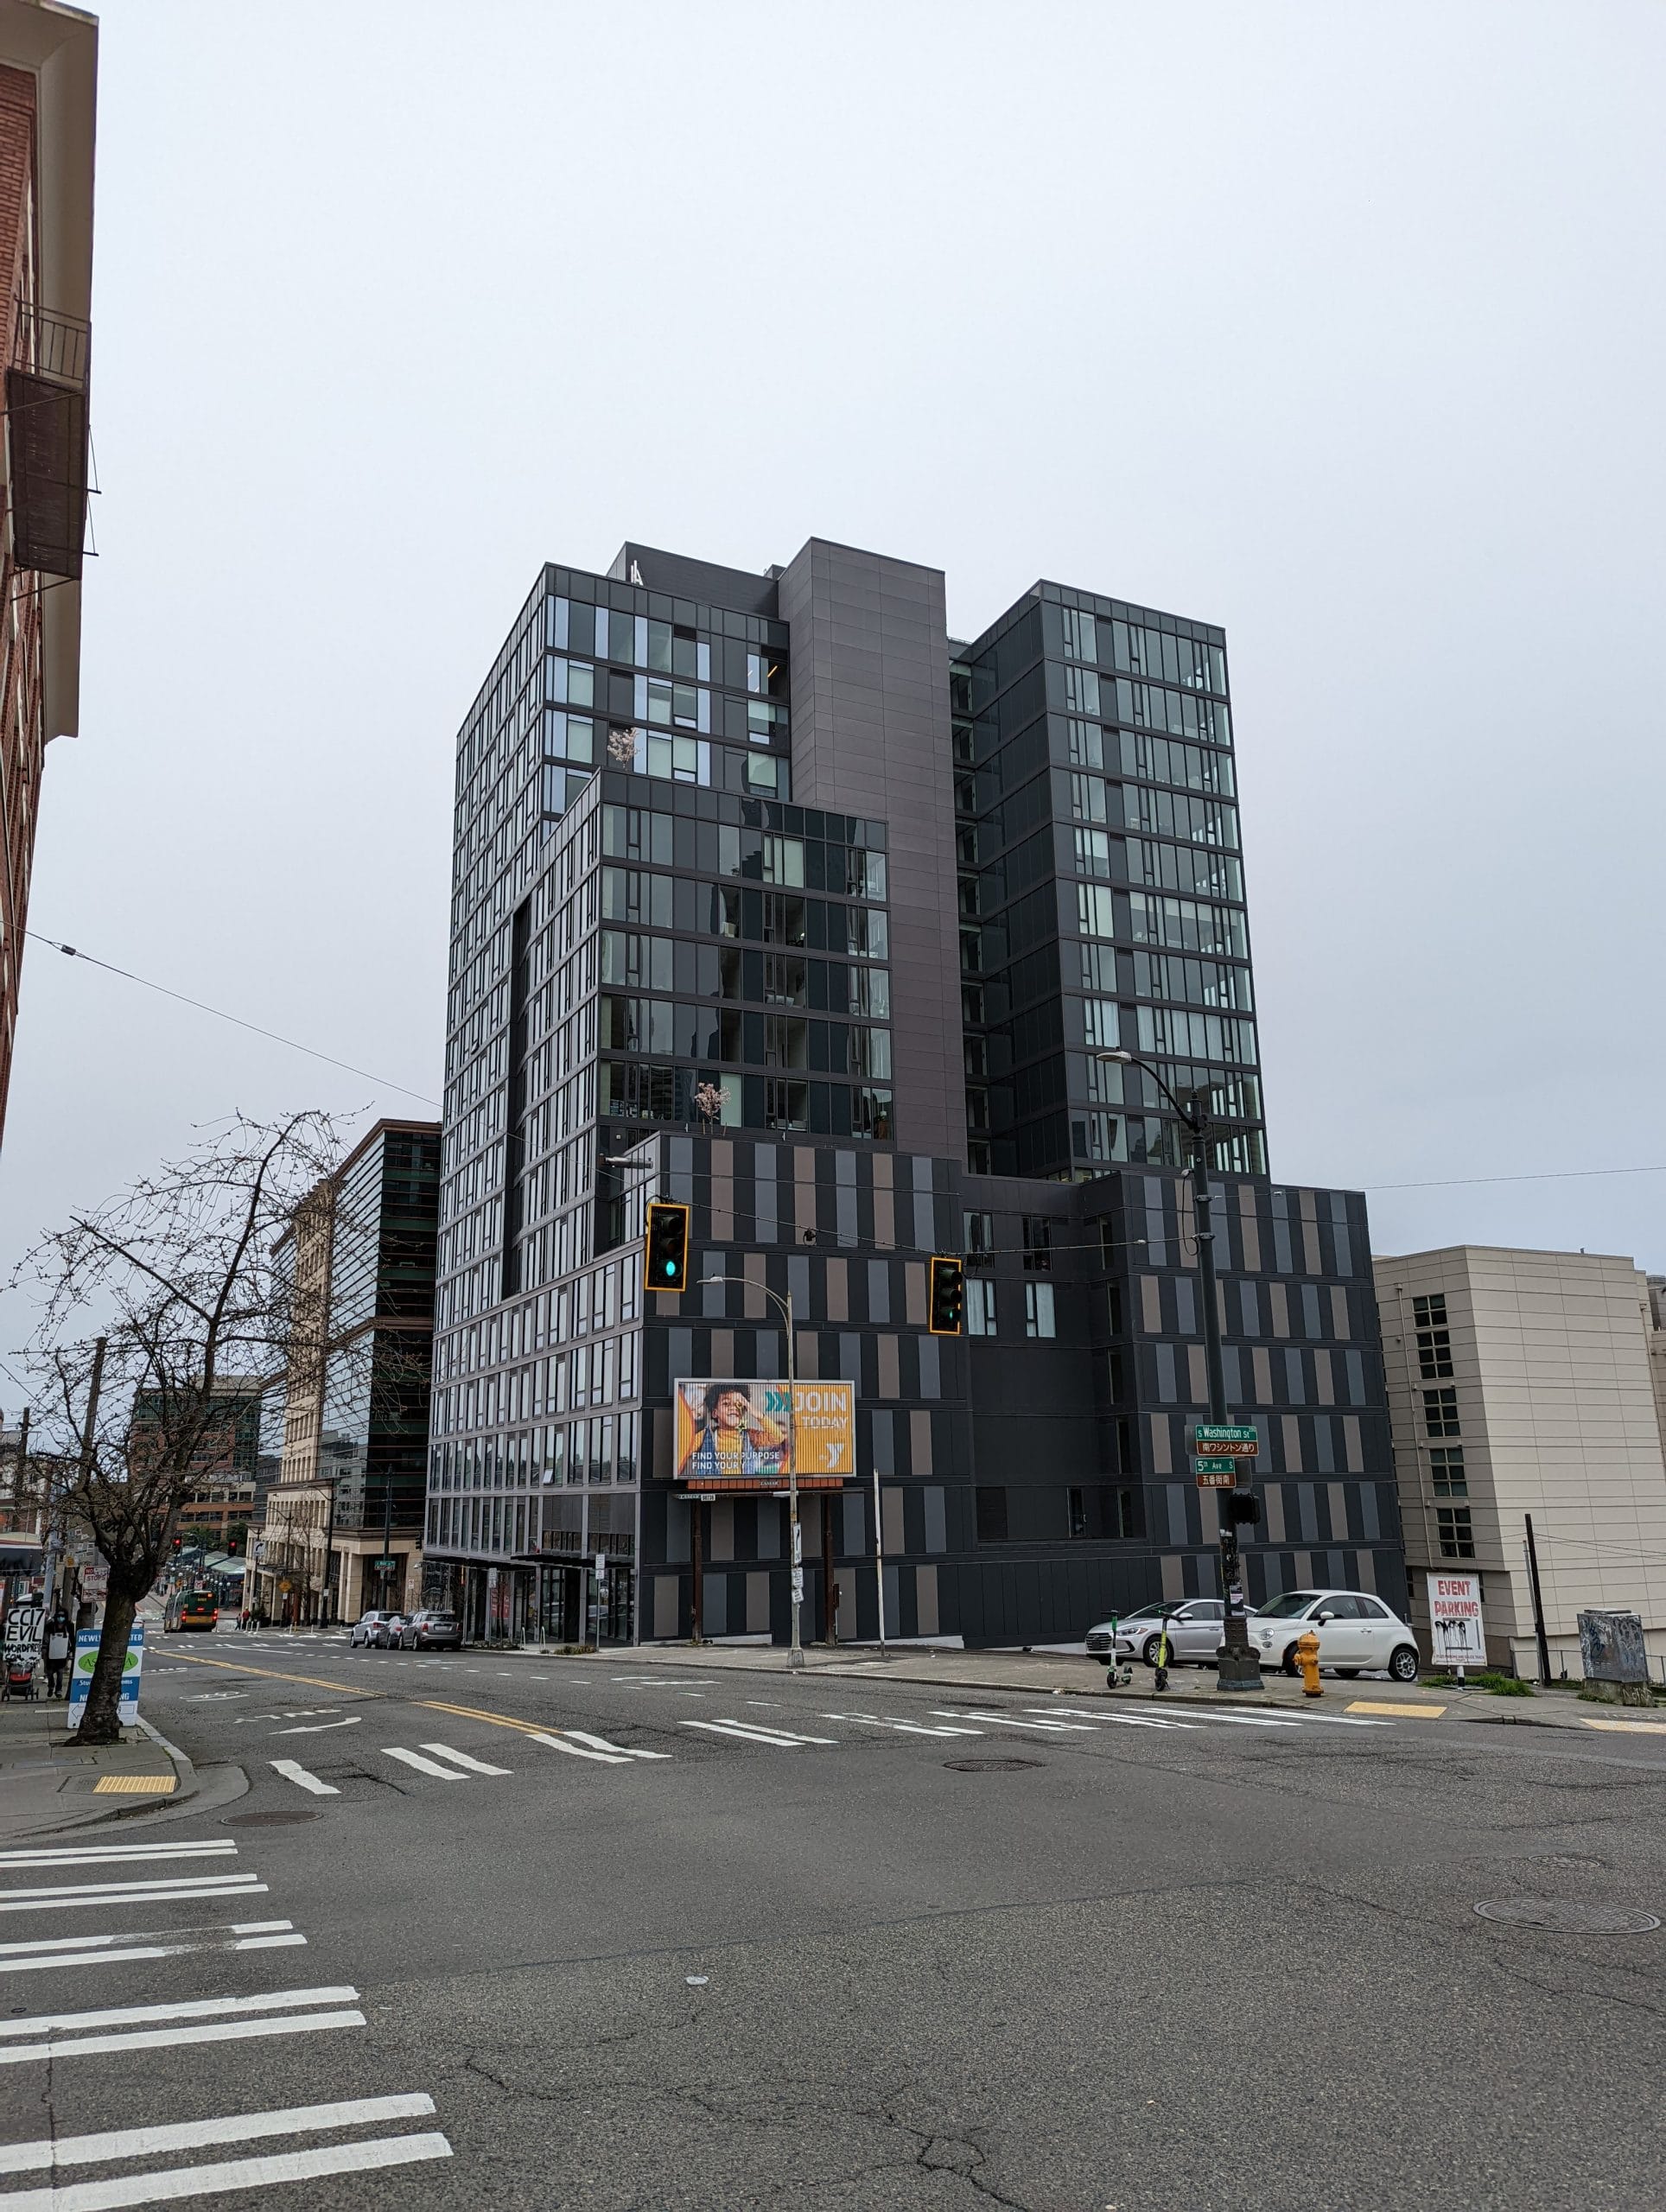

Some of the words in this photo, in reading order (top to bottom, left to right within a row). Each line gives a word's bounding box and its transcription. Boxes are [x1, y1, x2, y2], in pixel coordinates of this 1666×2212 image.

[795, 1391, 846, 1412] JOIN
[802, 1416, 849, 1429] TODAY
[1203, 1427, 1242, 1440] Washington
[692, 1452, 713, 1460] FIND
[715, 1452, 739, 1460] YOUR
[741, 1451, 779, 1460] PURPOSE
[692, 1461, 713, 1470] FIND
[715, 1461, 739, 1470] YOUR
[1198, 1460, 1208, 1471] 5th
[1437, 1580, 1471, 1597] EVENT
[1434, 1600, 1479, 1618] PARKING
